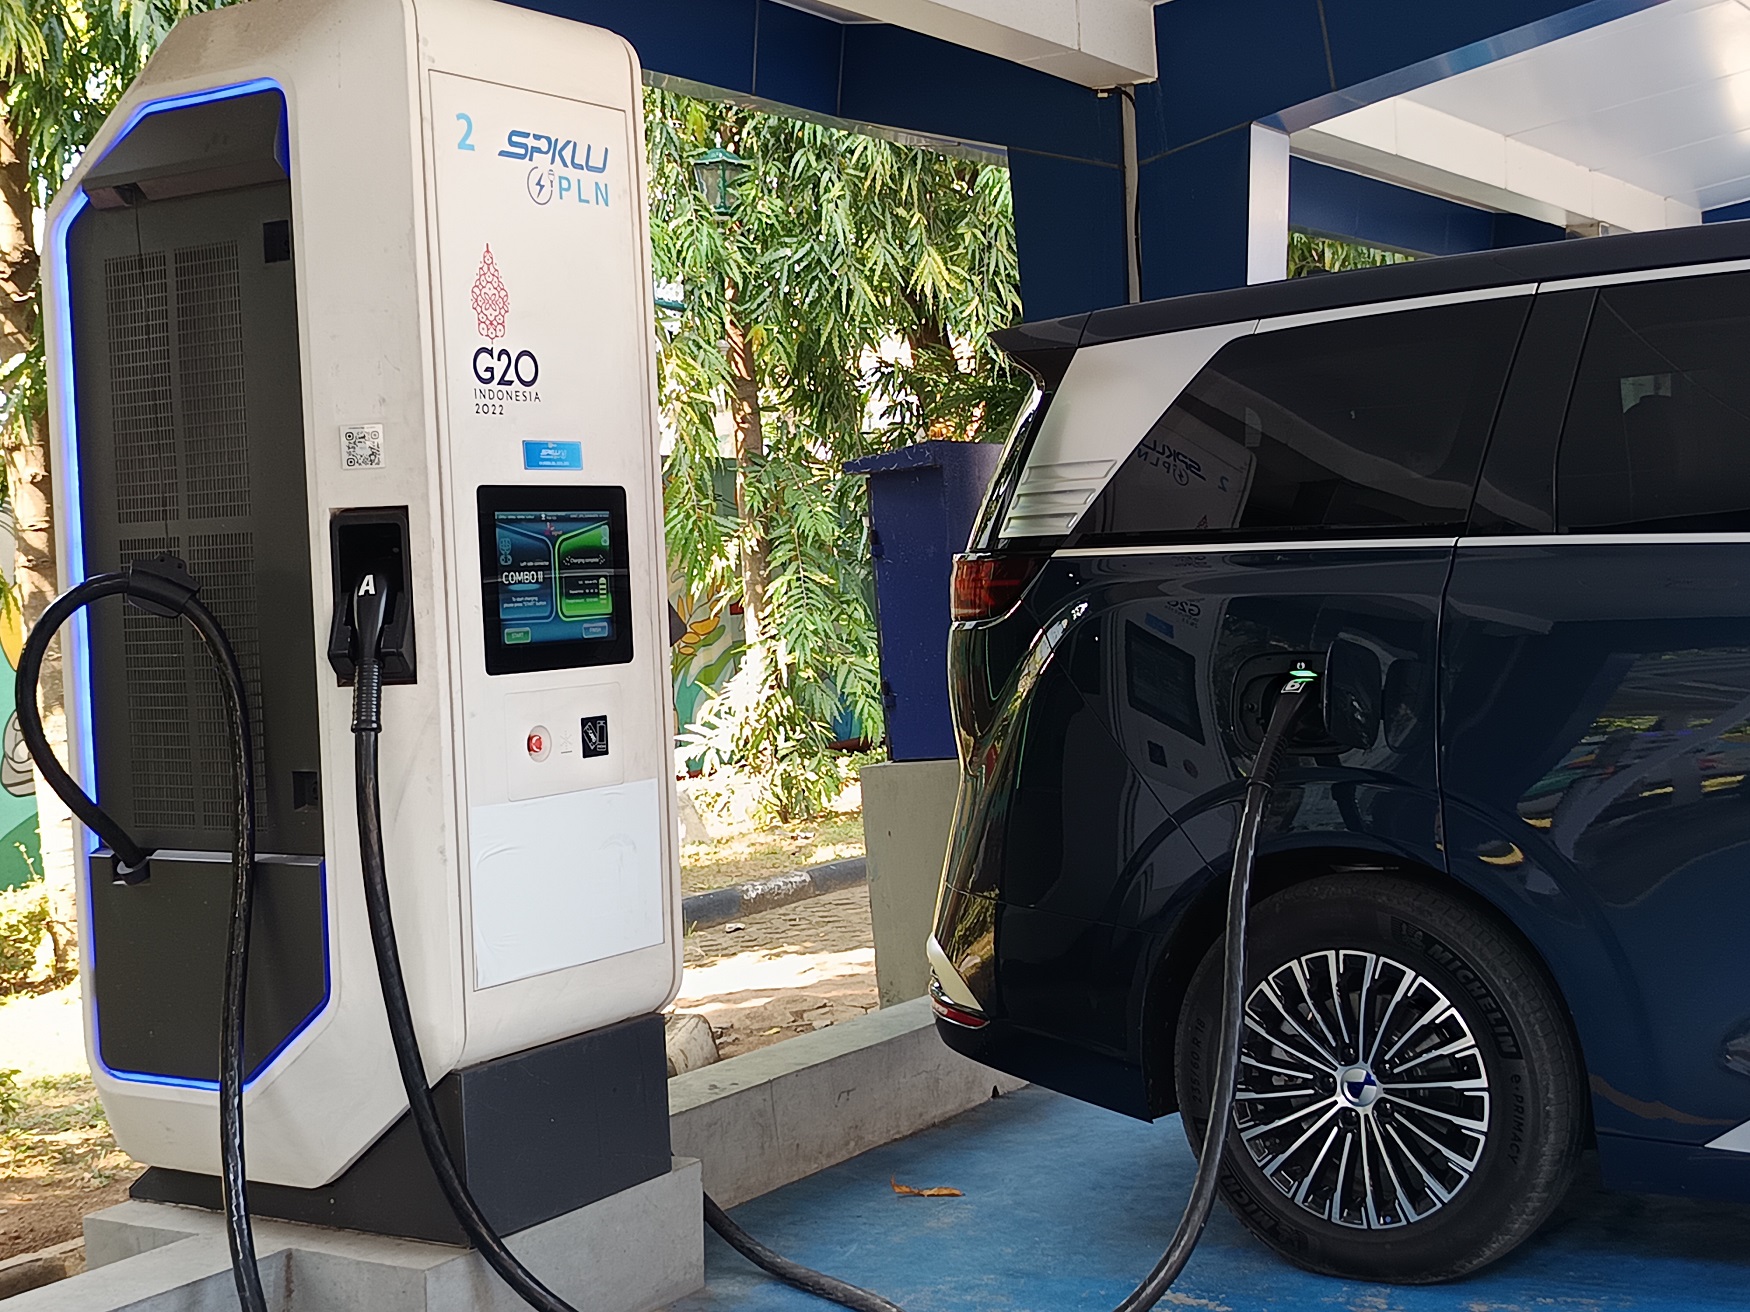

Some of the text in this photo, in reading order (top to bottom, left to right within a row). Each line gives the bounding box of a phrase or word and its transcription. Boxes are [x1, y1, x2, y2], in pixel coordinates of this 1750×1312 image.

[455, 112, 475, 151] 2
[497, 129, 609, 174] SPKLU
[558, 175, 610, 207] PLN
[472, 346, 539, 388] G20
[473, 388, 541, 403] INDONESIA
[475, 403, 505, 415] 2022
[358, 574, 376, 596] A
[502, 571, 537, 584] COMBO
[1427, 942, 1518, 1056] MICHELIN
